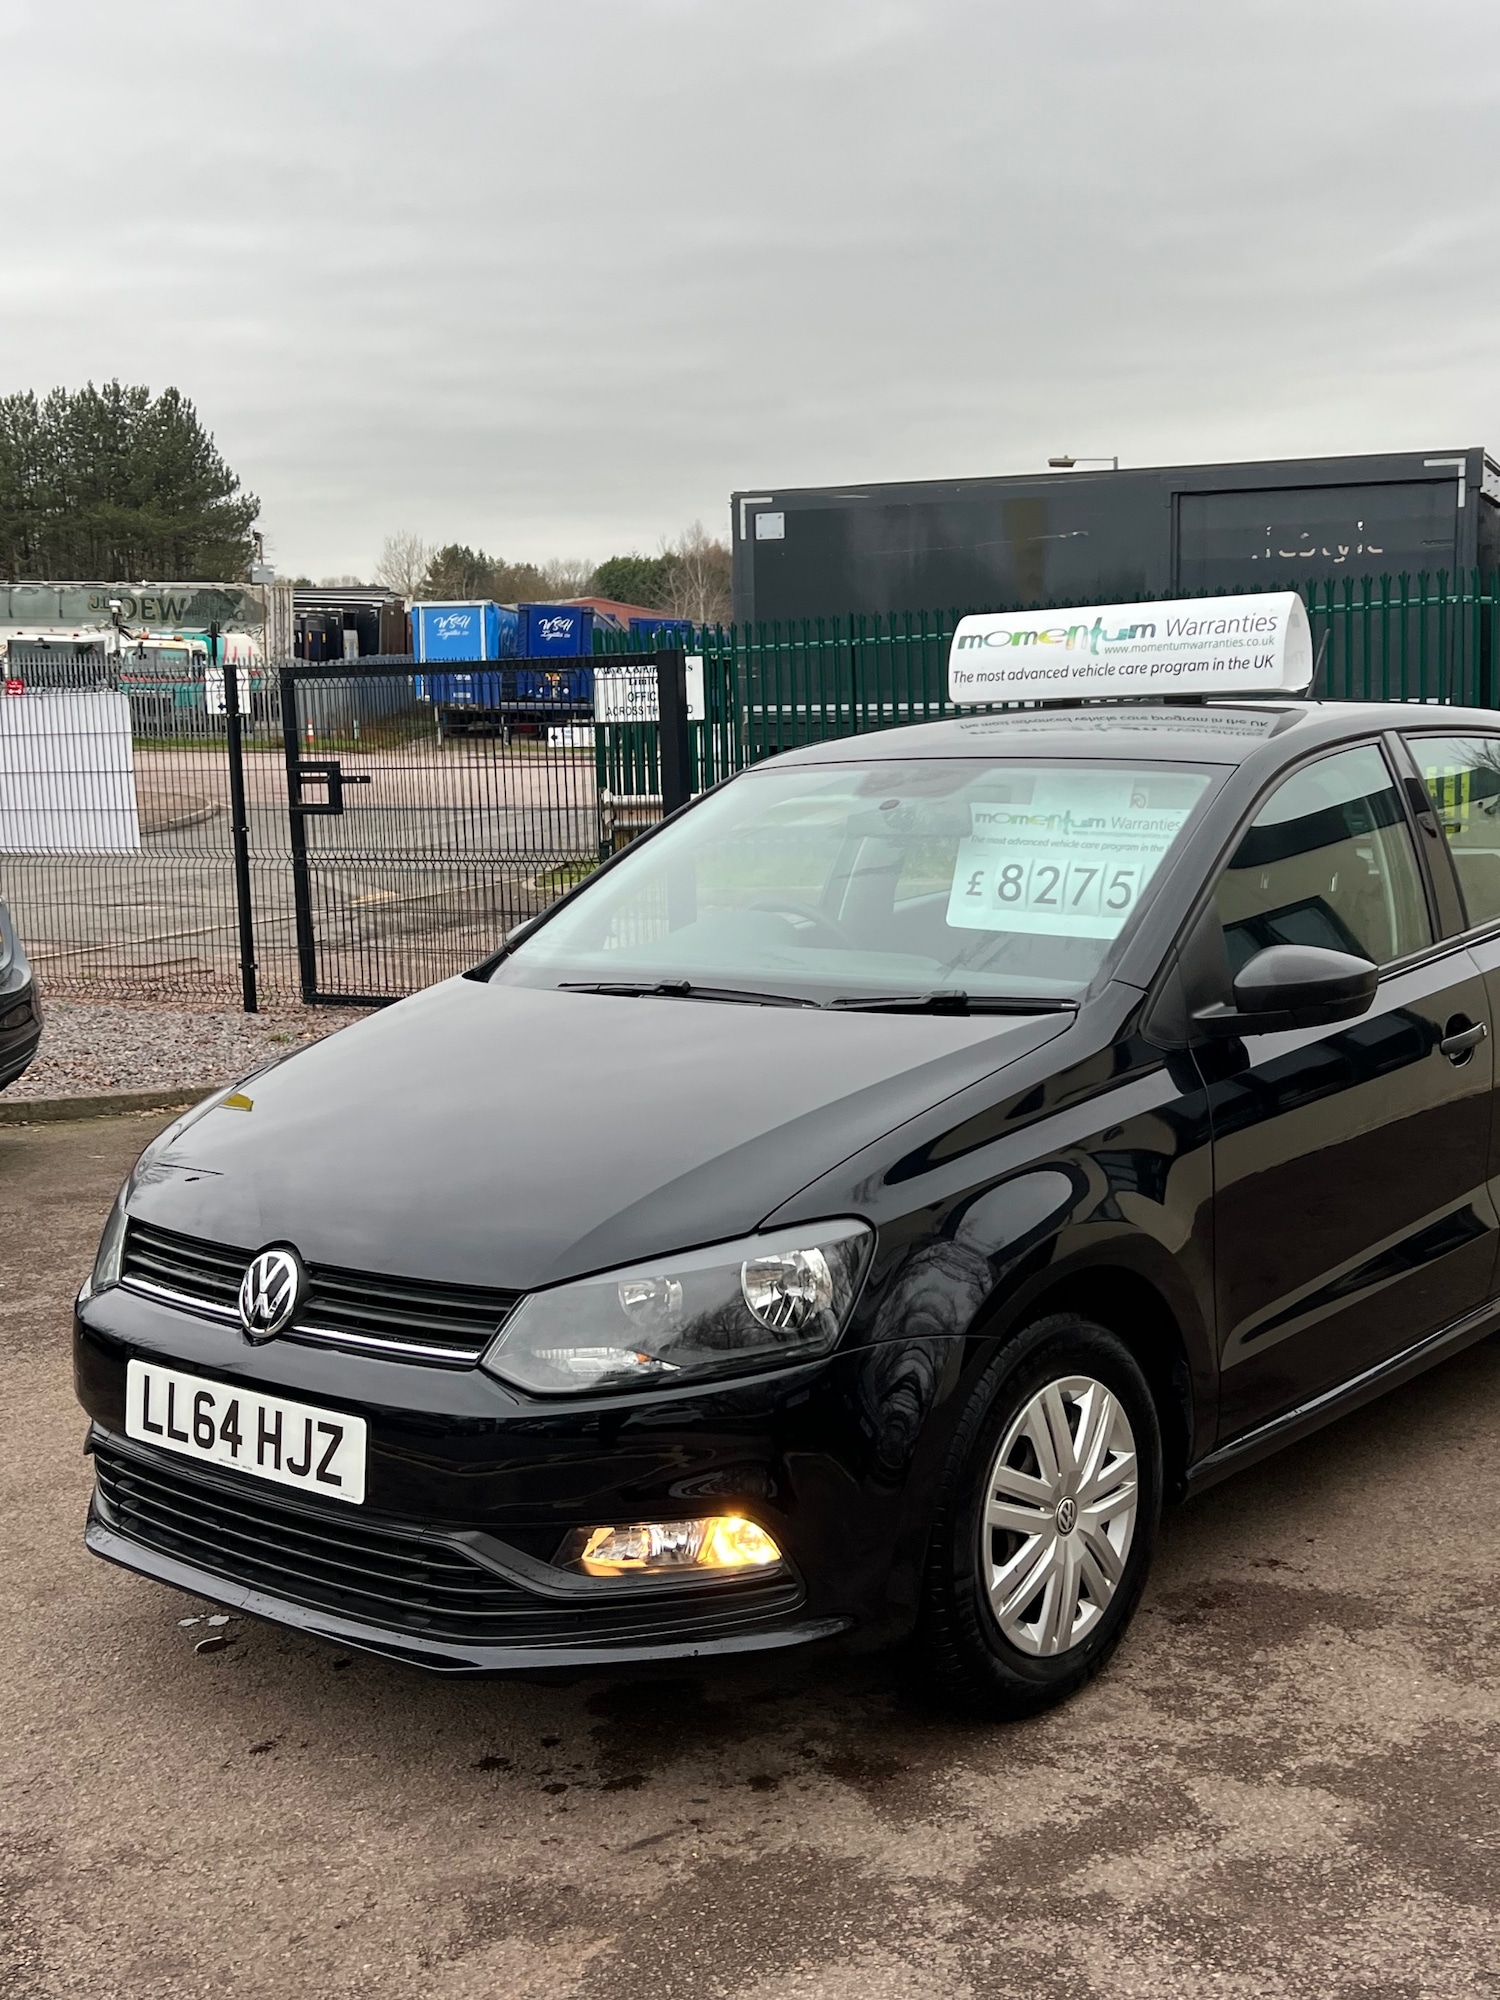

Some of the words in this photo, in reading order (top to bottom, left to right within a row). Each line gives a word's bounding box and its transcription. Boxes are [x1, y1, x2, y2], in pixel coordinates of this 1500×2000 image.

[119, 597, 187, 620] DEW
[957, 617, 1156, 655] momentum
[1166, 613, 1278, 637] Warranties
[1104, 635, 1275, 655] www.momentumwarranties.co.uk
[953, 671, 974, 684] The
[976, 671, 1005, 683] most
[1007, 665, 1070, 681] advanced
[1072, 663, 1115, 678] vehicle
[1118, 664, 1148, 676] care
[1150, 660, 1209, 676] program
[1212, 657, 1225, 671] in
[1228, 656, 1250, 670] the
[1254, 654, 1276, 669] UK
[627, 691, 658, 703] OFFIC
[605, 705, 645, 716] ACROSS
[974, 810, 1106, 835] momentum
[1111, 816, 1181, 832] Warranties
[971, 835, 986, 844] The
[1007, 837, 1050, 847] advanced
[1050, 838, 1080, 849] vehicle
[1080, 841, 1099, 849] care
[1101, 842, 1139, 852] program
[1140, 843, 1149, 851] in
[1150, 844, 1165, 852] the
[966, 870, 985, 897] £
[997, 864, 1135, 910] 8275
[142, 1374, 243, 1459] LL64
[256, 1406, 344, 1487] HJZ
